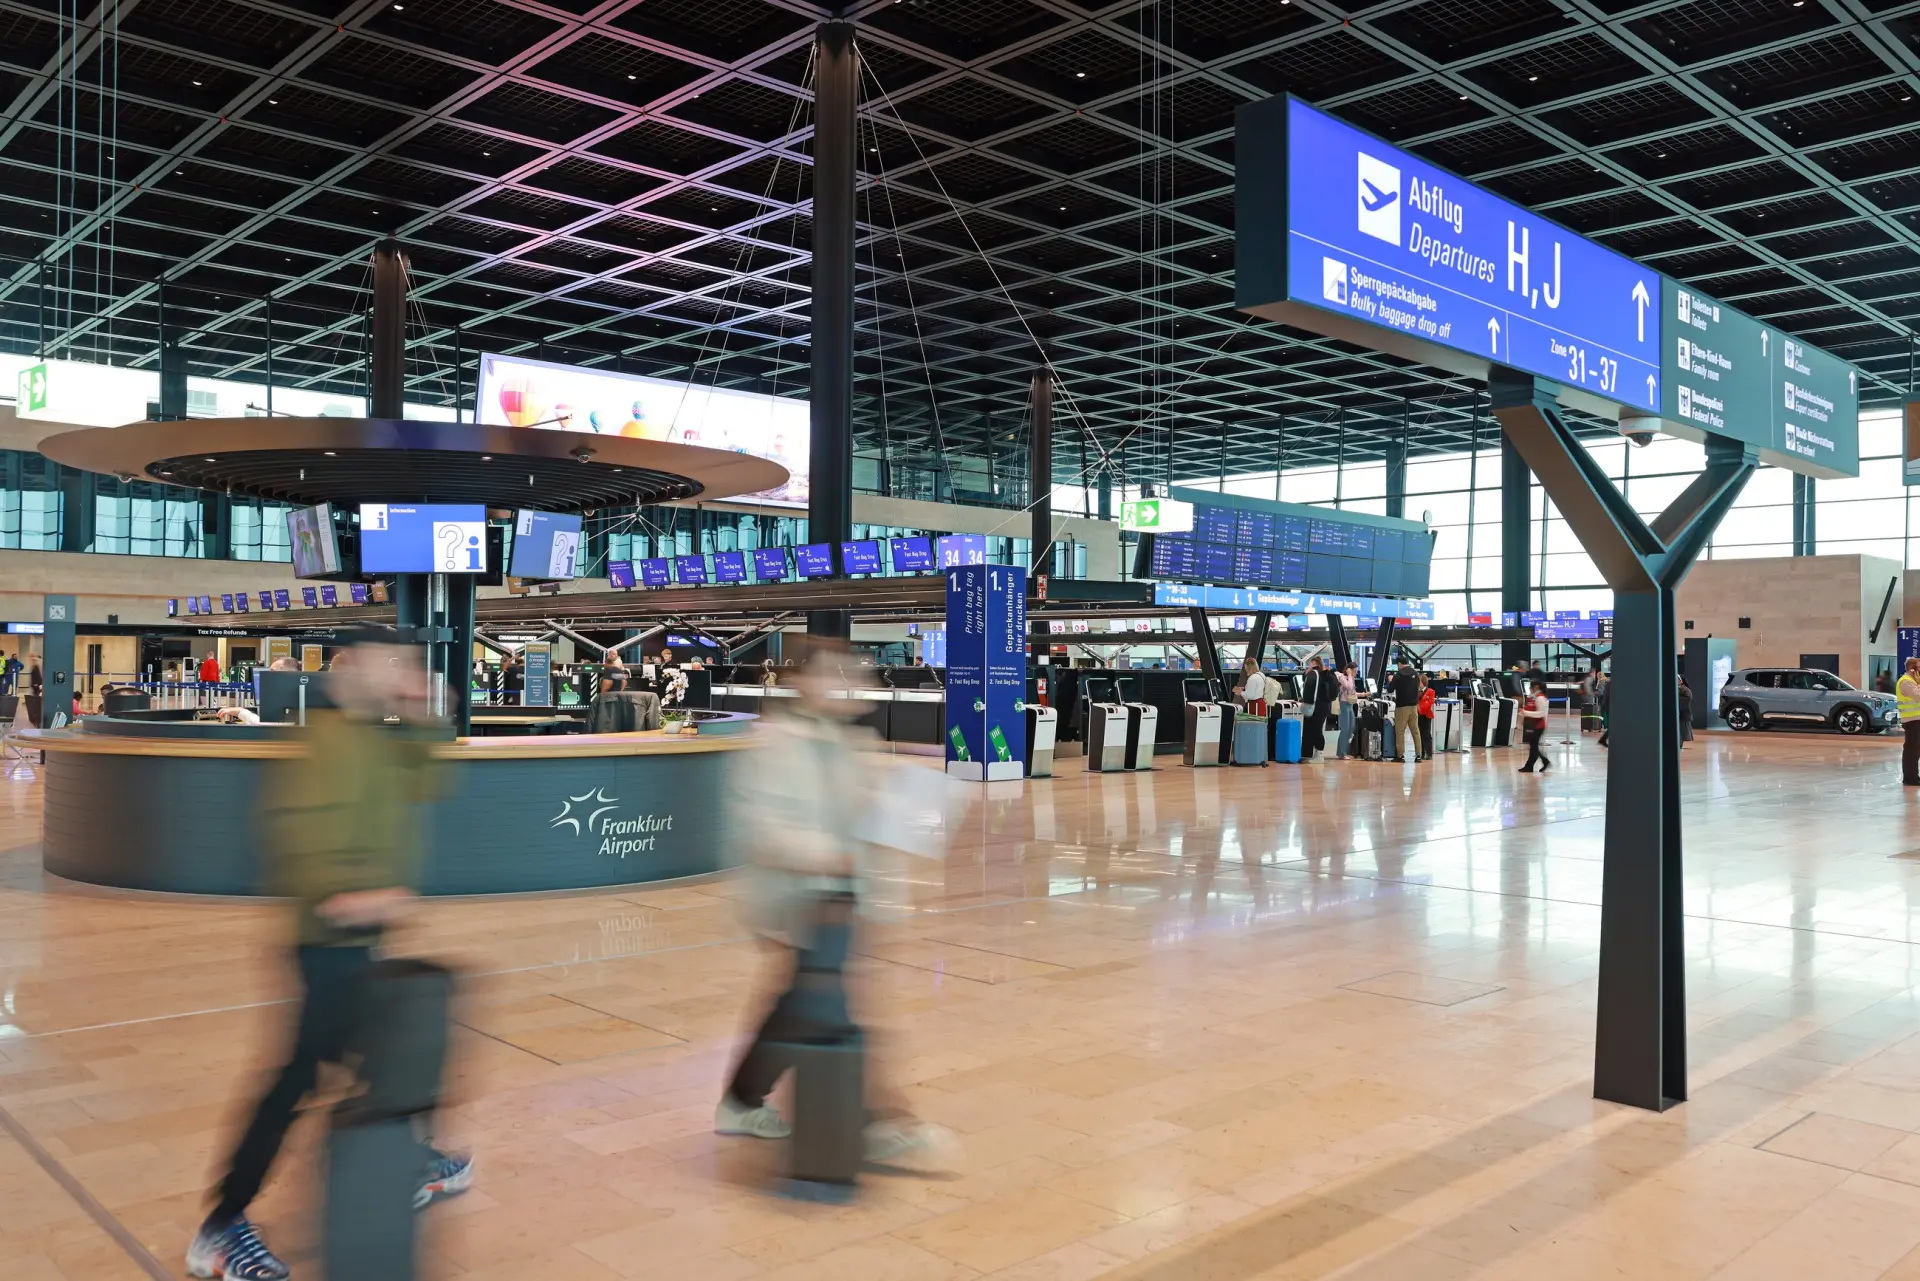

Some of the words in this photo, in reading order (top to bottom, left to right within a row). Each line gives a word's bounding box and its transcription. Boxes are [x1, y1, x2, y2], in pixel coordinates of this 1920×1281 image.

[1408, 177, 1463, 234] Abflug
[1408, 222, 1495, 283] Departures
[1507, 220, 1561, 309] H,J
[1351, 266, 1436, 312] Sperrgepäckabgabe
[1351, 291, 1377, 318] Bulky
[1379, 301, 1416, 329] baggage
[1418, 315, 1436, 337] drop
[1439, 323, 1451, 339] off
[1551, 338, 1567, 358] Zone
[945, 550, 959, 566] 34
[968, 550, 983, 565] 34
[950, 572, 961, 592] 1.
[966, 571, 975, 587] tag
[990, 571, 1001, 591] 1.
[966, 591, 974, 608] bag
[975, 586, 983, 608] here
[965, 610, 973, 634] Print
[975, 610, 984, 634] right
[1005, 572, 1015, 653] Gepäckanhänger
[1505, 618, 1514, 626] 36
[1900, 630, 1909, 640] 1.
[601, 814, 673, 836] Frankfurt
[598, 835, 656, 859] Airport
